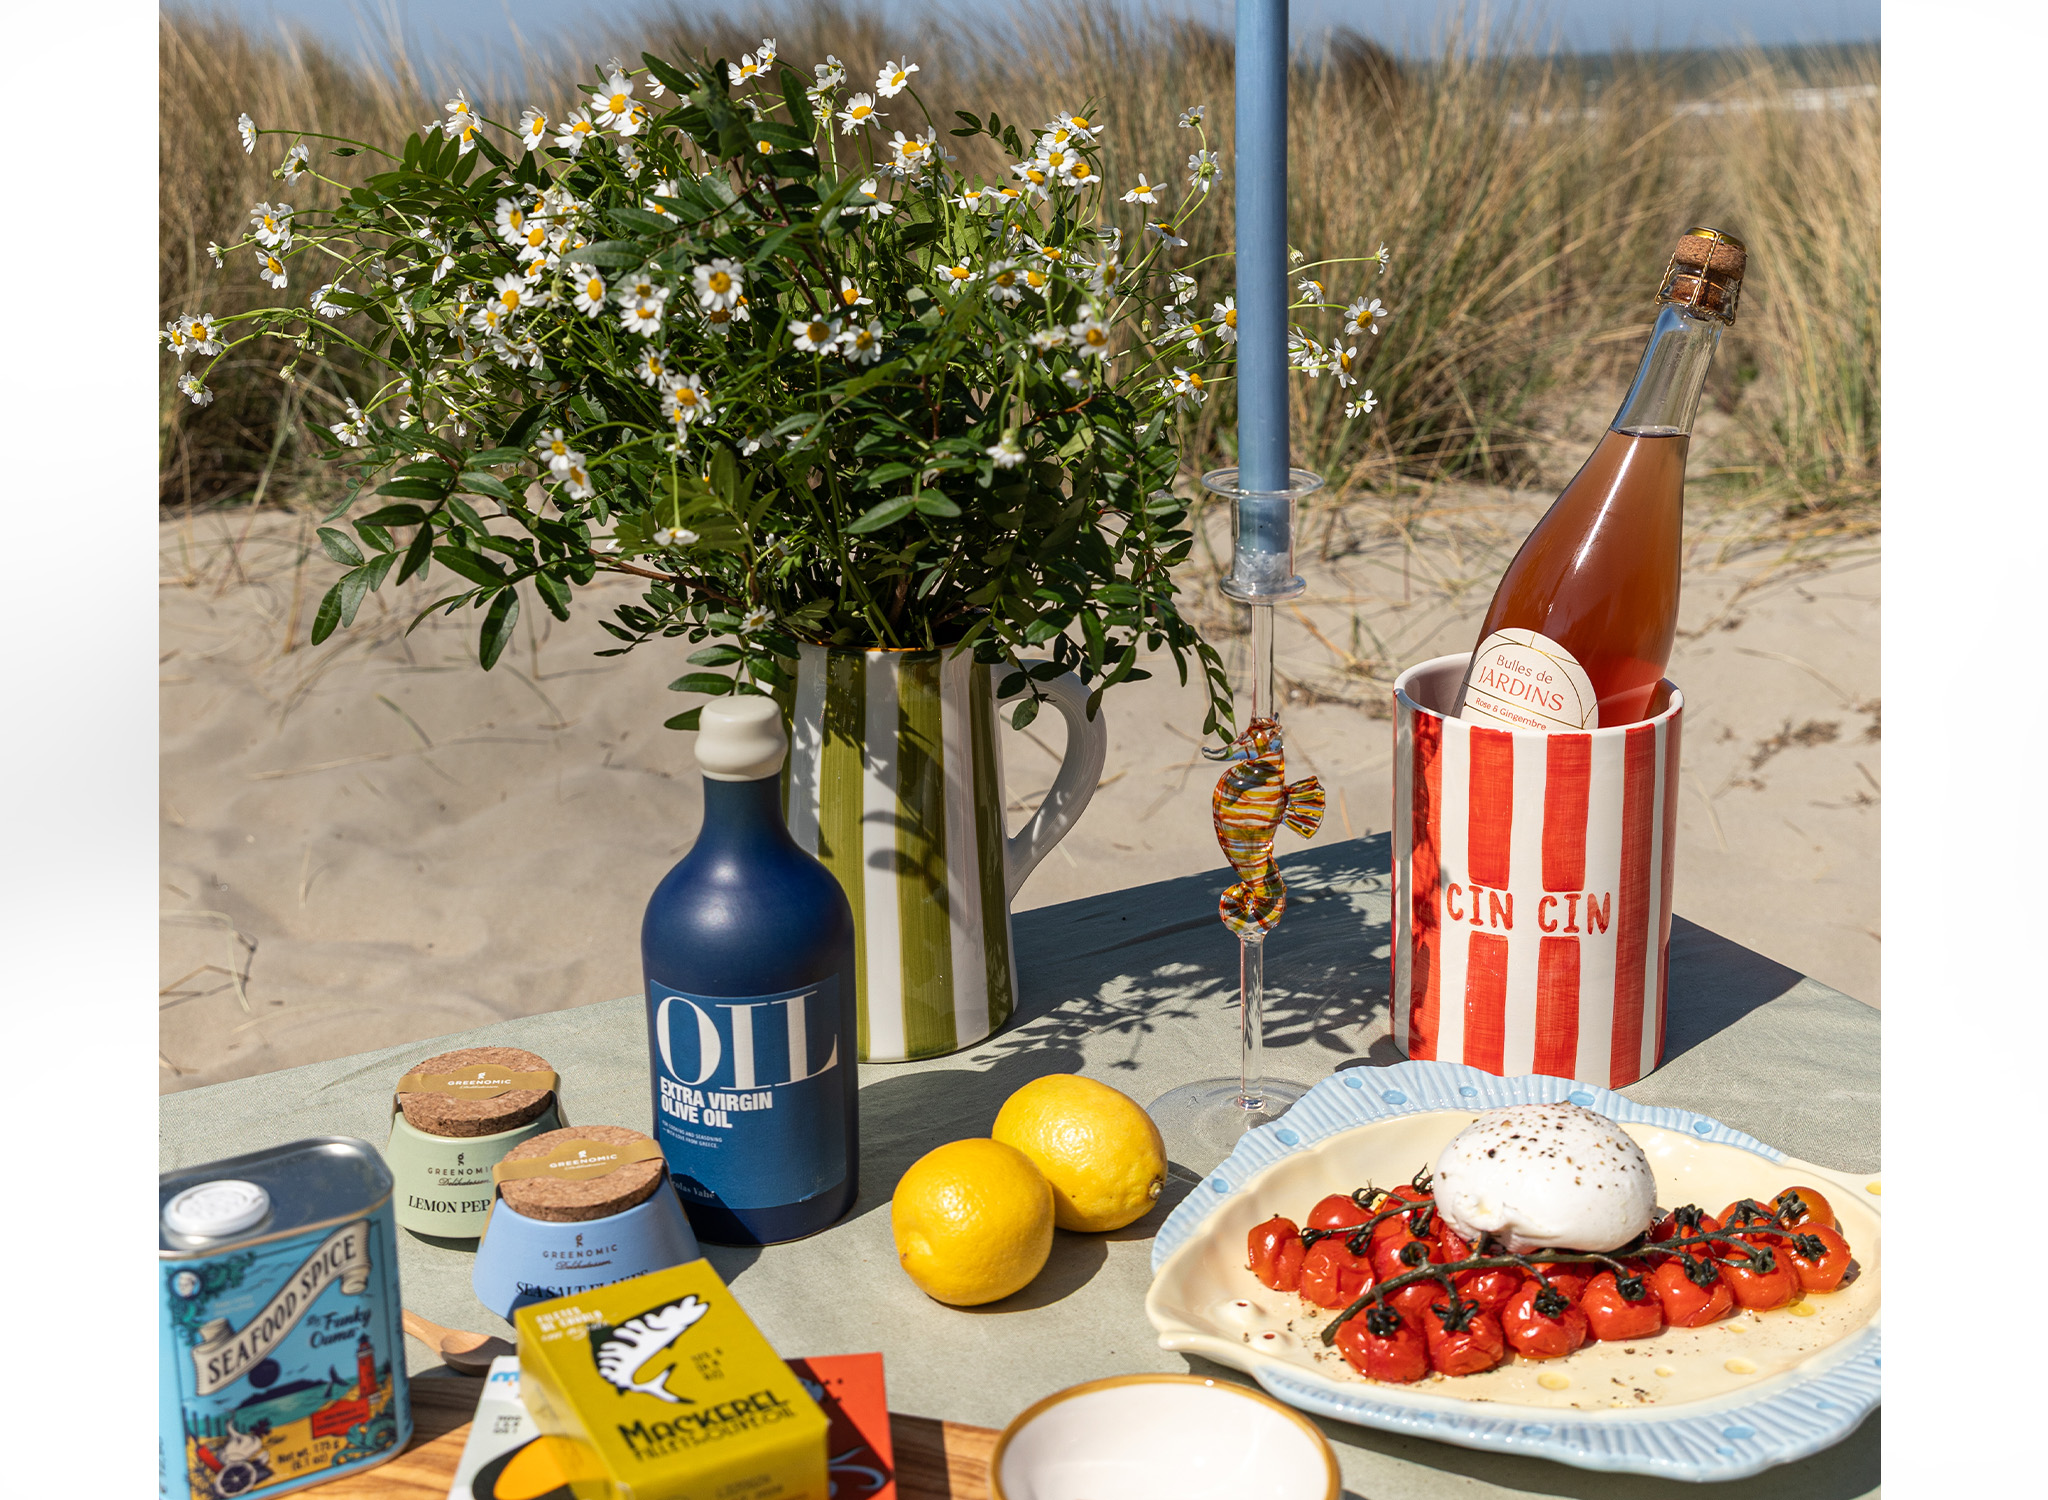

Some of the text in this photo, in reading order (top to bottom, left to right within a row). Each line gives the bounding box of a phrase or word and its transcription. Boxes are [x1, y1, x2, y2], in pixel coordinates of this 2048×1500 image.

[1496, 654, 1553, 685] Bulles de
[1478, 666, 1565, 712] JARDINS
[1475, 697, 1492, 711] Rose
[1500, 707, 1547, 731] Gingembre
[1447, 883, 1611, 935] CIN CIN
[656, 990, 838, 1090] OIL
[447, 1078, 512, 1086] GREENOMIC
[660, 1076, 773, 1112] EXTRA VIRGIN
[660, 1094, 733, 1129] OLIVE OIL
[685, 1130, 694, 1138] AND
[695, 1133, 723, 1143] SEASONING
[548, 1153, 618, 1169] GREENOMIC
[408, 1194, 458, 1213] LEMON
[542, 1243, 618, 1259] GREENOMIC
[516, 1281, 543, 1298] SEA
[208, 1235, 357, 1384] SEAFOOD SPICE
[617, 1389, 791, 1451] MACKEREL
